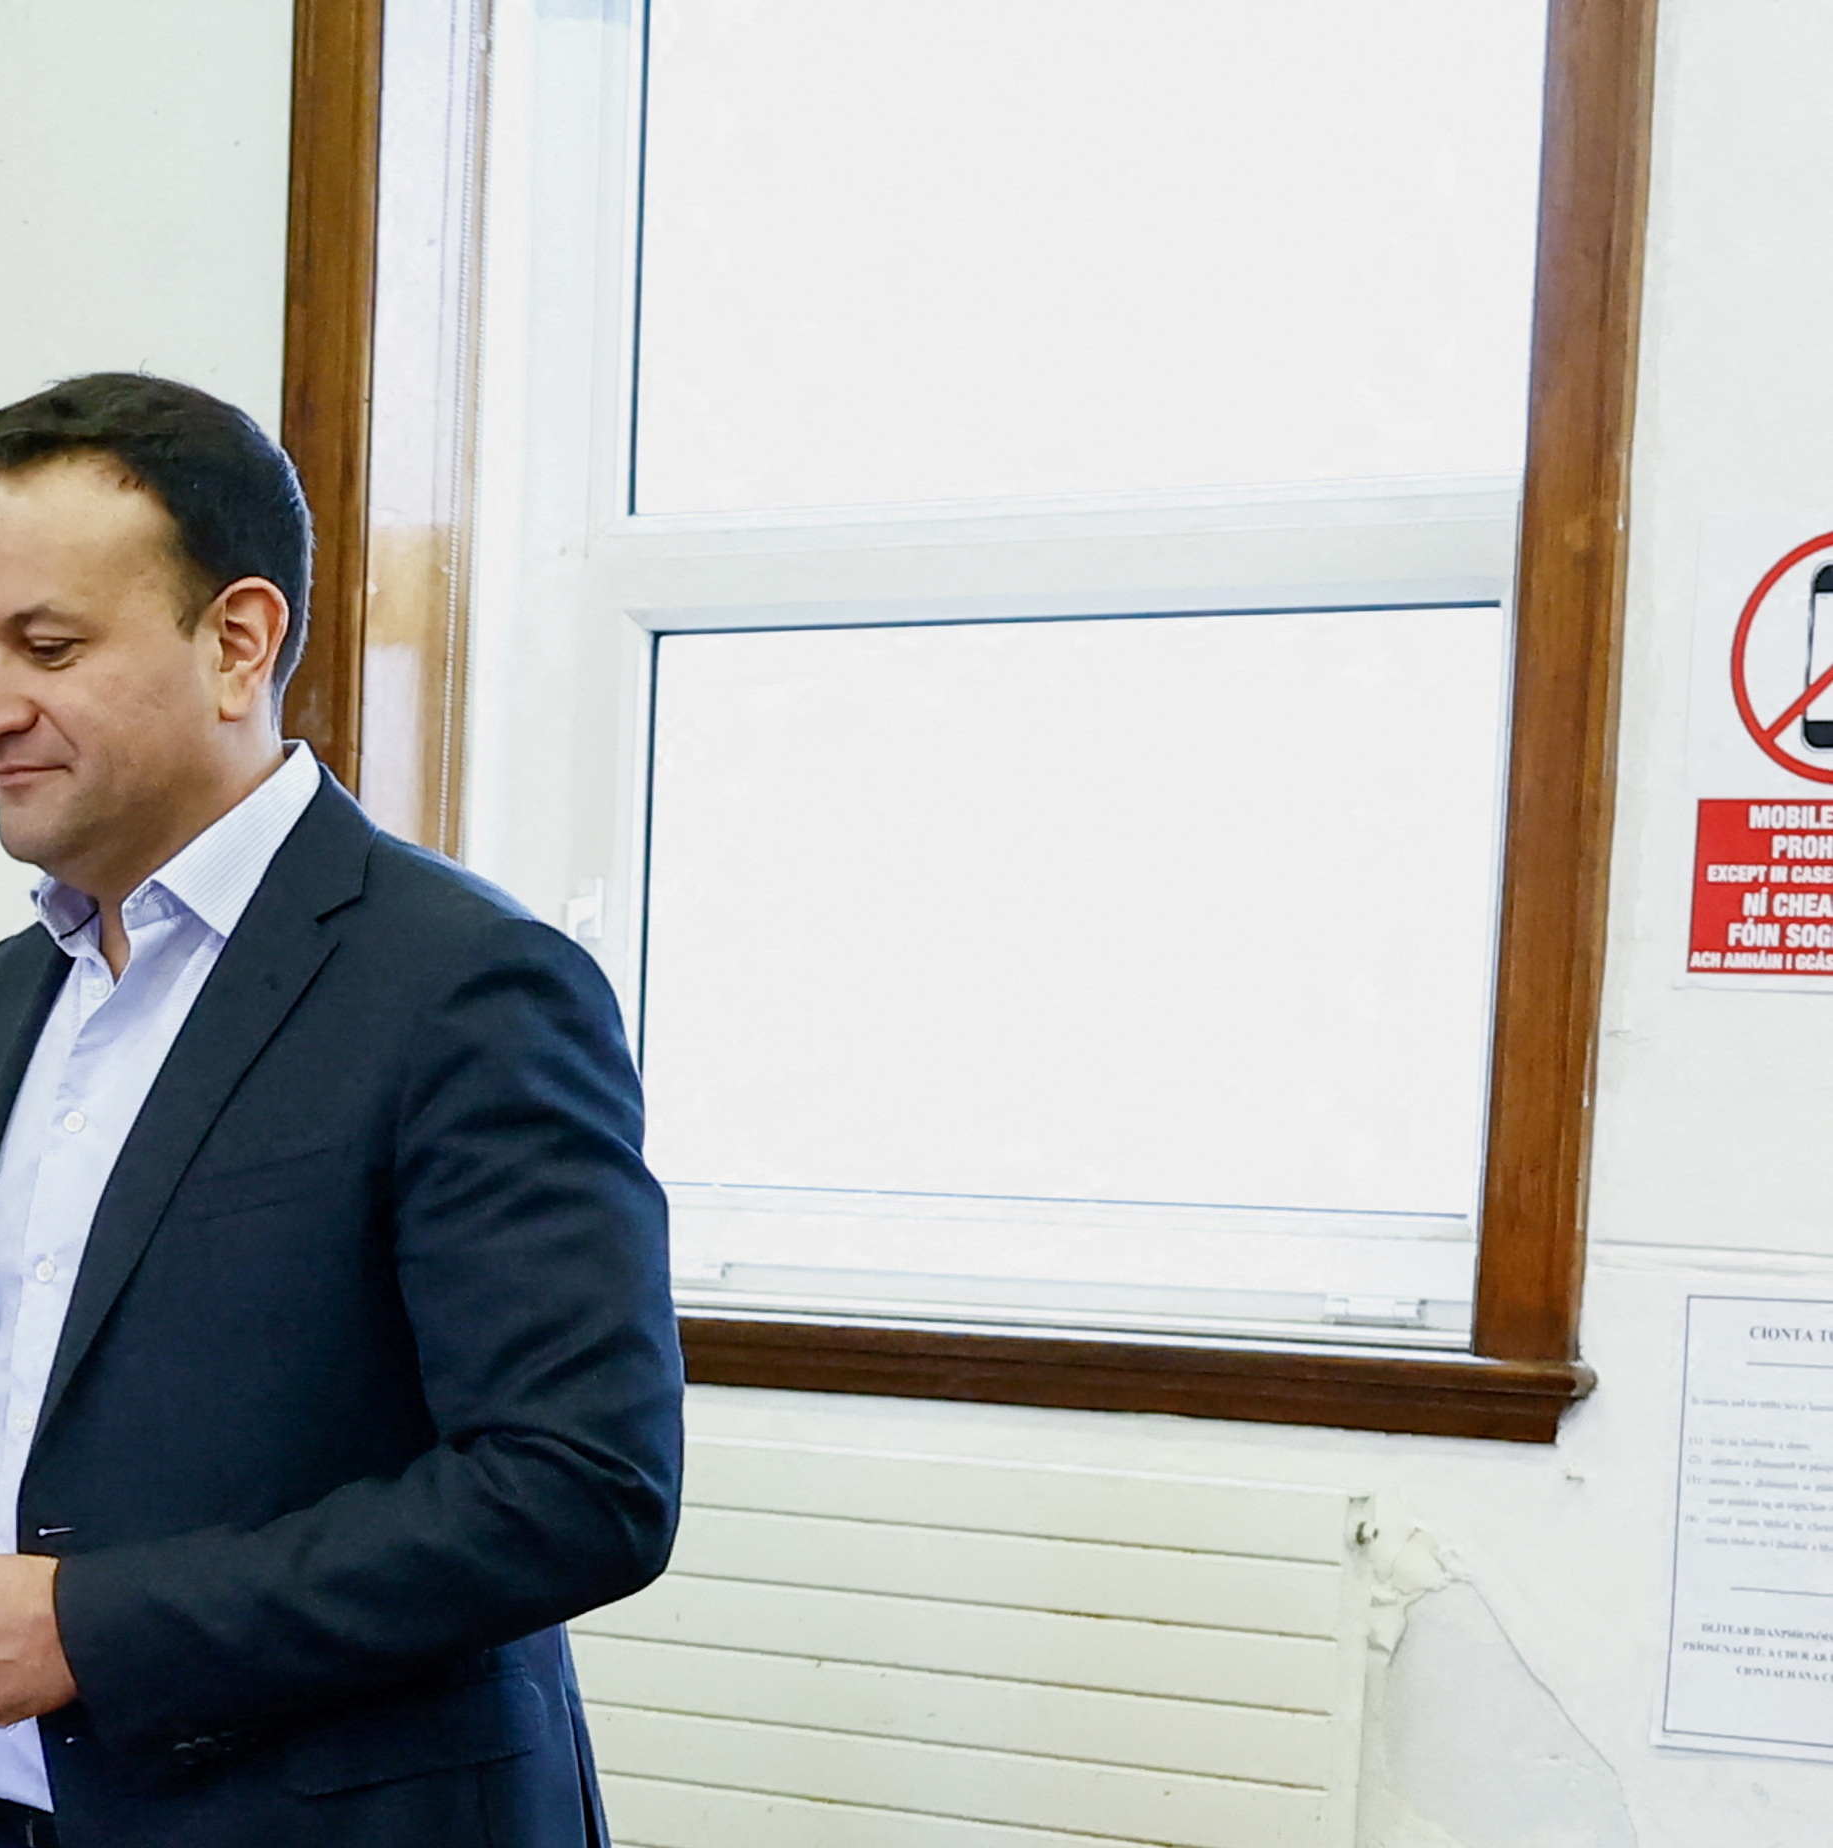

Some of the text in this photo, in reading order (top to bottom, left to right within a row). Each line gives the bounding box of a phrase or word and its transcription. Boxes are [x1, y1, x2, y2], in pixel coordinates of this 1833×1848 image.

[1749, 804, 1833, 830] MOBILE
[1771, 834, 1833, 860] PROH
[1707, 864, 1767, 883] EXCEPT
[1770, 865, 1788, 883] IN
[1785, 922, 1833, 949] SOG
[1690, 951, 1722, 968] ACH
[1749, 1325, 1813, 1342] CIONTA
